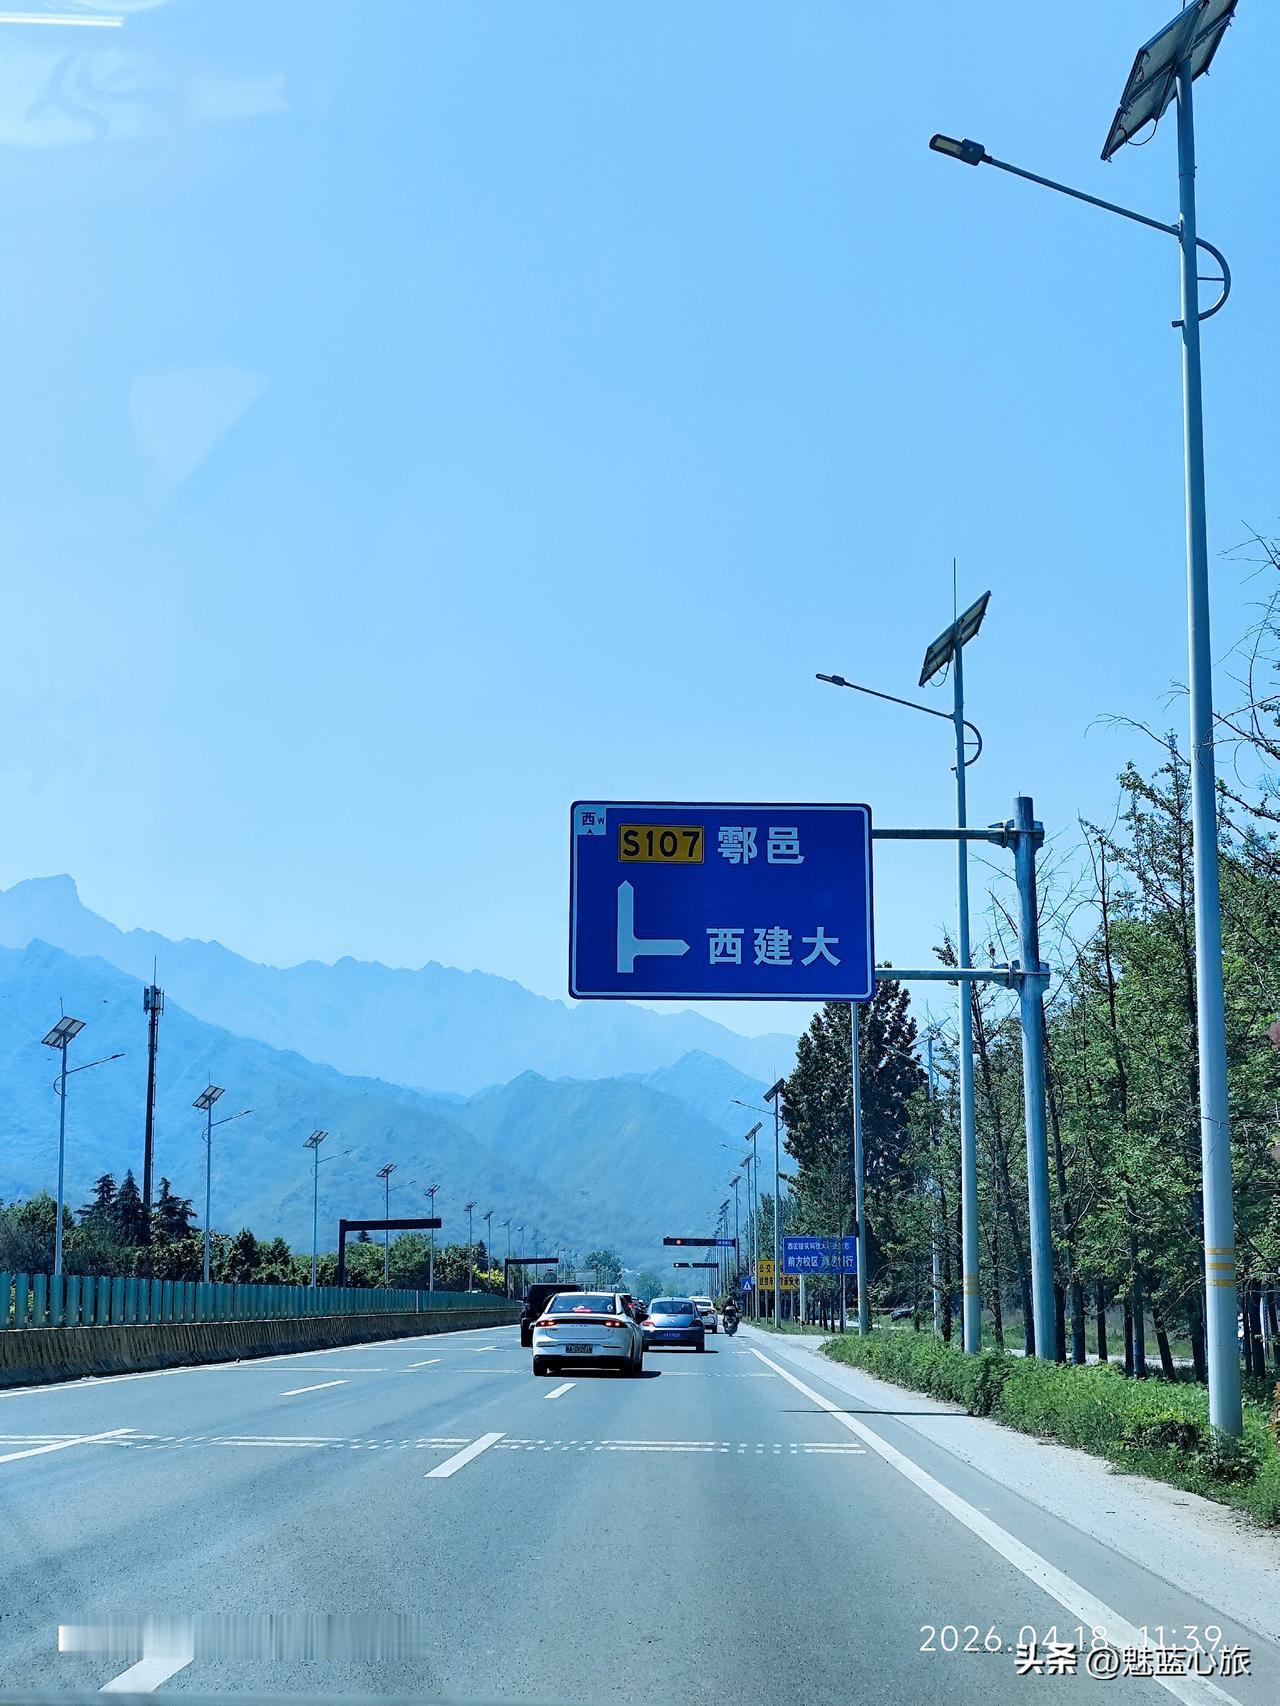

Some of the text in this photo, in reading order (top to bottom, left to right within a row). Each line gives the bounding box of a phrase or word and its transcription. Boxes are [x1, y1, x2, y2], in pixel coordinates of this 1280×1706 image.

[581, 811, 605, 826] 西 W
[622, 829, 701, 858] S107
[717, 826, 805, 865] 鄠邑
[706, 926, 841, 966] 西建大
[787, 1256, 818, 1267] 前方校区
